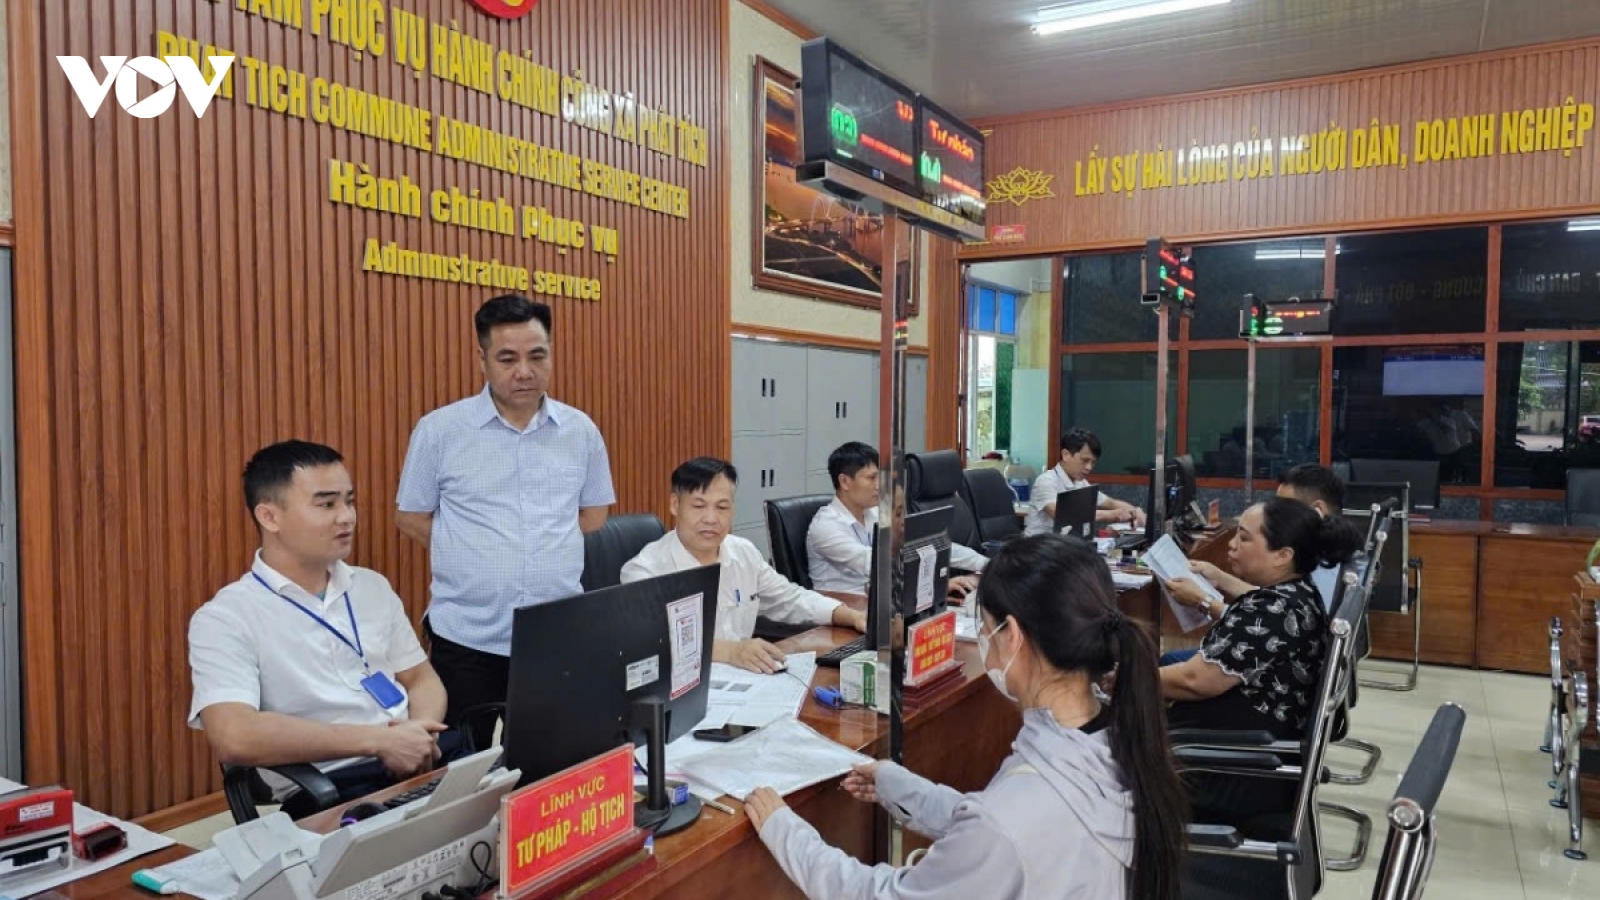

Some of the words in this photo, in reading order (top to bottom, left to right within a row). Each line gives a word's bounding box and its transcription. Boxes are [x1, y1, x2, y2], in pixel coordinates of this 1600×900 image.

[392, 6, 426, 78] VỤ
[432, 19, 493, 95] HÀNH
[498, 50, 559, 117] CHÍNH
[561, 69, 612, 136] CÔNG
[242, 56, 306, 119] TICH
[311, 77, 432, 151] COMMUNE
[435, 114, 581, 191] ADMINISTRATIVE
[582, 158, 641, 207] SERVICE
[641, 176, 689, 219] CENTER
[1075, 143, 1108, 197] LẤY
[1111, 149, 1138, 198] SỰ
[1142, 142, 1173, 190] HÀI
[1177, 138, 1228, 186] LÒNG
[1232, 126, 1274, 182] CỦA
[1280, 120, 1348, 176] NGƯỜI
[1352, 117, 1408, 170] DÂN,
[1414, 113, 1495, 164] DOANH
[1500, 95, 1594, 158] NGHIỆP
[328, 158, 421, 218] Hành
[431, 186, 514, 236] chính
[590, 224, 618, 264] vụ
[516, 833, 536, 868] TƯ
[536, 817, 572, 859] PHÁP
[581, 803, 598, 837] HỘ
[600, 793, 625, 829] TỊCH
[540, 789, 574, 817] LĨNH
[577, 775, 606, 799] VỰC
